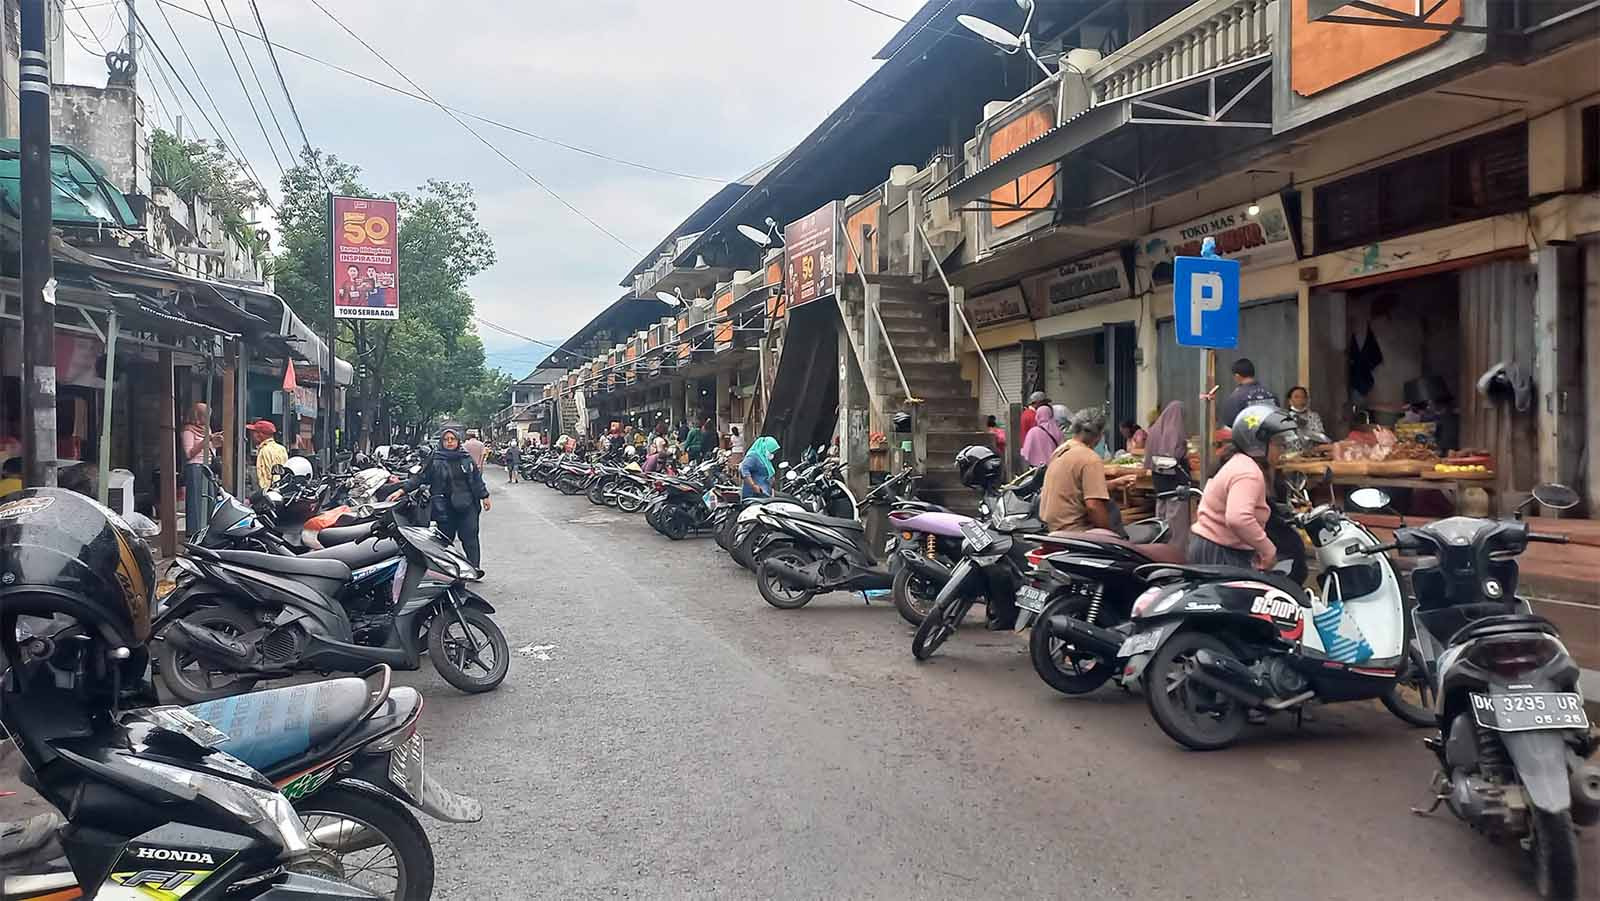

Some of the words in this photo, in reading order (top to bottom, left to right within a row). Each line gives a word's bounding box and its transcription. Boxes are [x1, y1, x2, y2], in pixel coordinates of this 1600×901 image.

[343, 212, 390, 245] 50
[1180, 223, 1208, 240] TOKO
[1210, 215, 1234, 231] MAS
[339, 308, 357, 316] TOKO
[358, 309, 379, 317] SERBA
[1190, 272, 1224, 337] P
[1250, 596, 1302, 621] SCOOPY
[1473, 694, 1495, 711] DK
[1503, 696, 1545, 711] 3295
[1557, 696, 1579, 711] UR
[137, 847, 215, 865] HONDA
